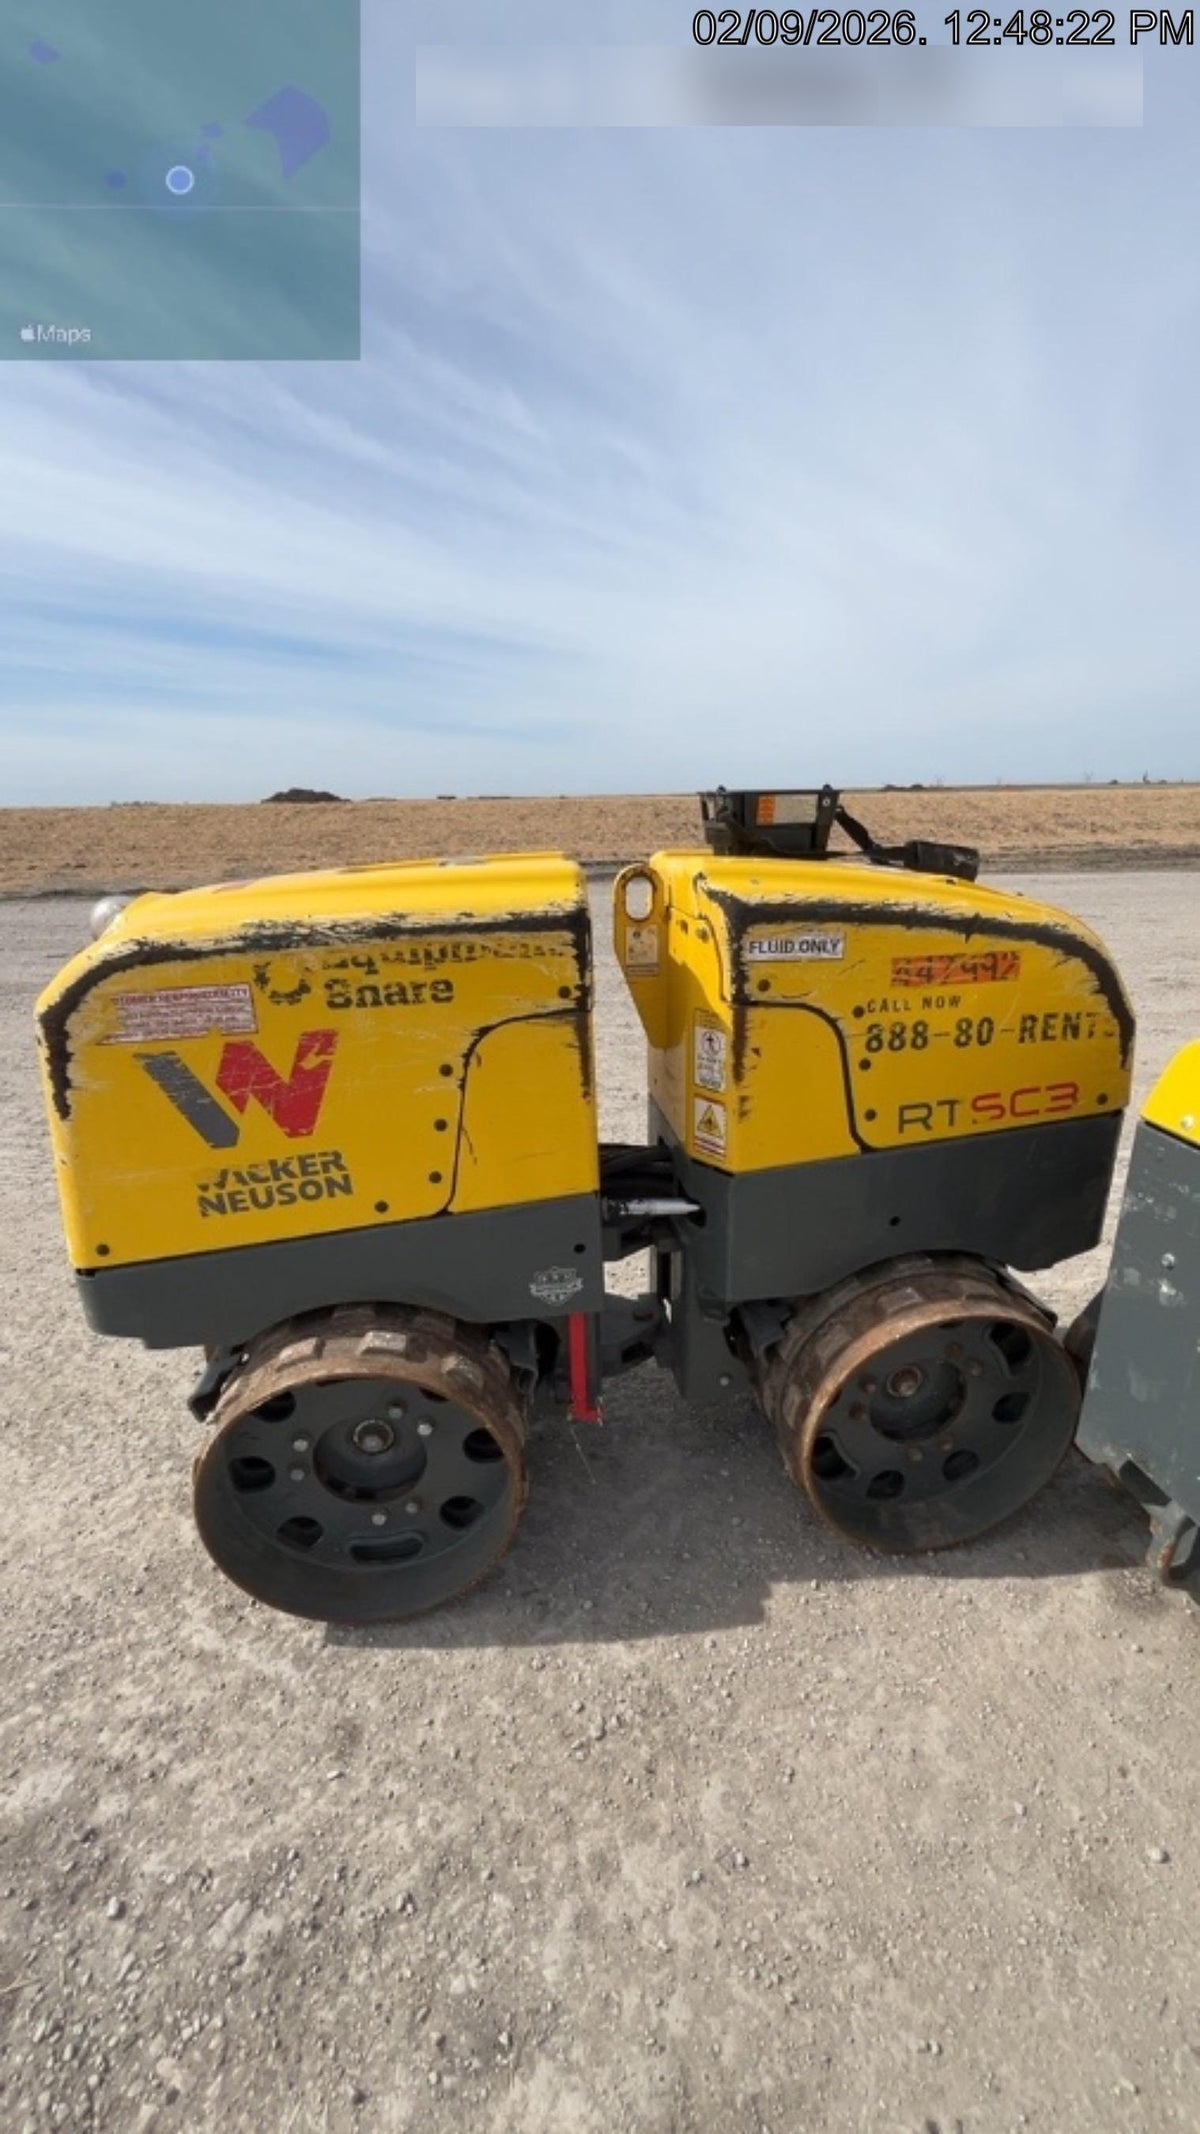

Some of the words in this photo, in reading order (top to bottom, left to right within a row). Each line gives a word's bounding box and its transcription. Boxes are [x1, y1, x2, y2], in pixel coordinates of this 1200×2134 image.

[749, 940, 795, 954] FLUID
[799, 938, 840, 954] ONLY
[867, 997, 912, 1014] CALL
[922, 995, 962, 1010] NOW
[865, 1011, 1115, 1053] 888-80-RENT
[197, 1174, 354, 1217] NEUSON
